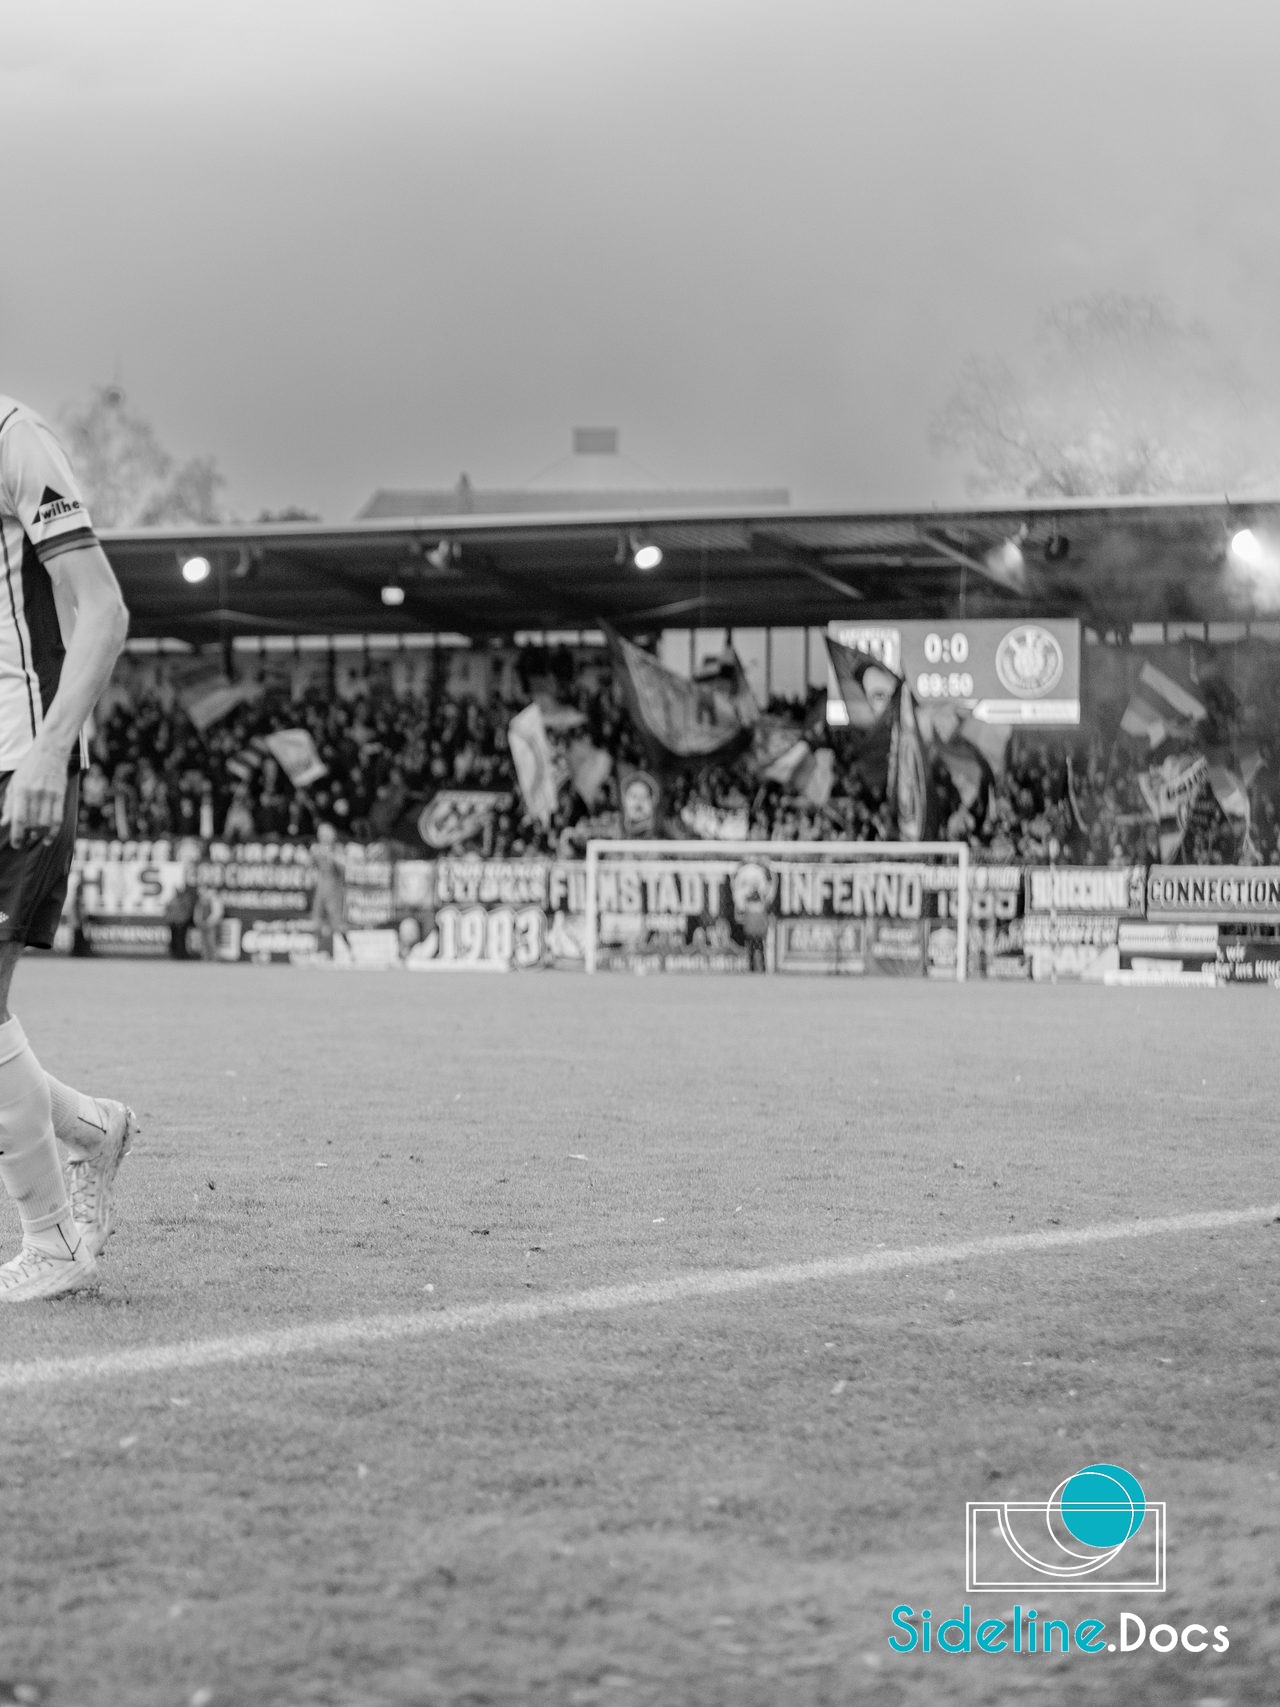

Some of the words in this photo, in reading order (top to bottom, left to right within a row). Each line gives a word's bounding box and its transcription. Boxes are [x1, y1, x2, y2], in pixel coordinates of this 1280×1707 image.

[924, 633, 969, 664] 0:0
[779, 869, 920, 919] INFERNO
[1151, 880, 1280, 903] CONNECTION
[436, 906, 545, 968] 1903
